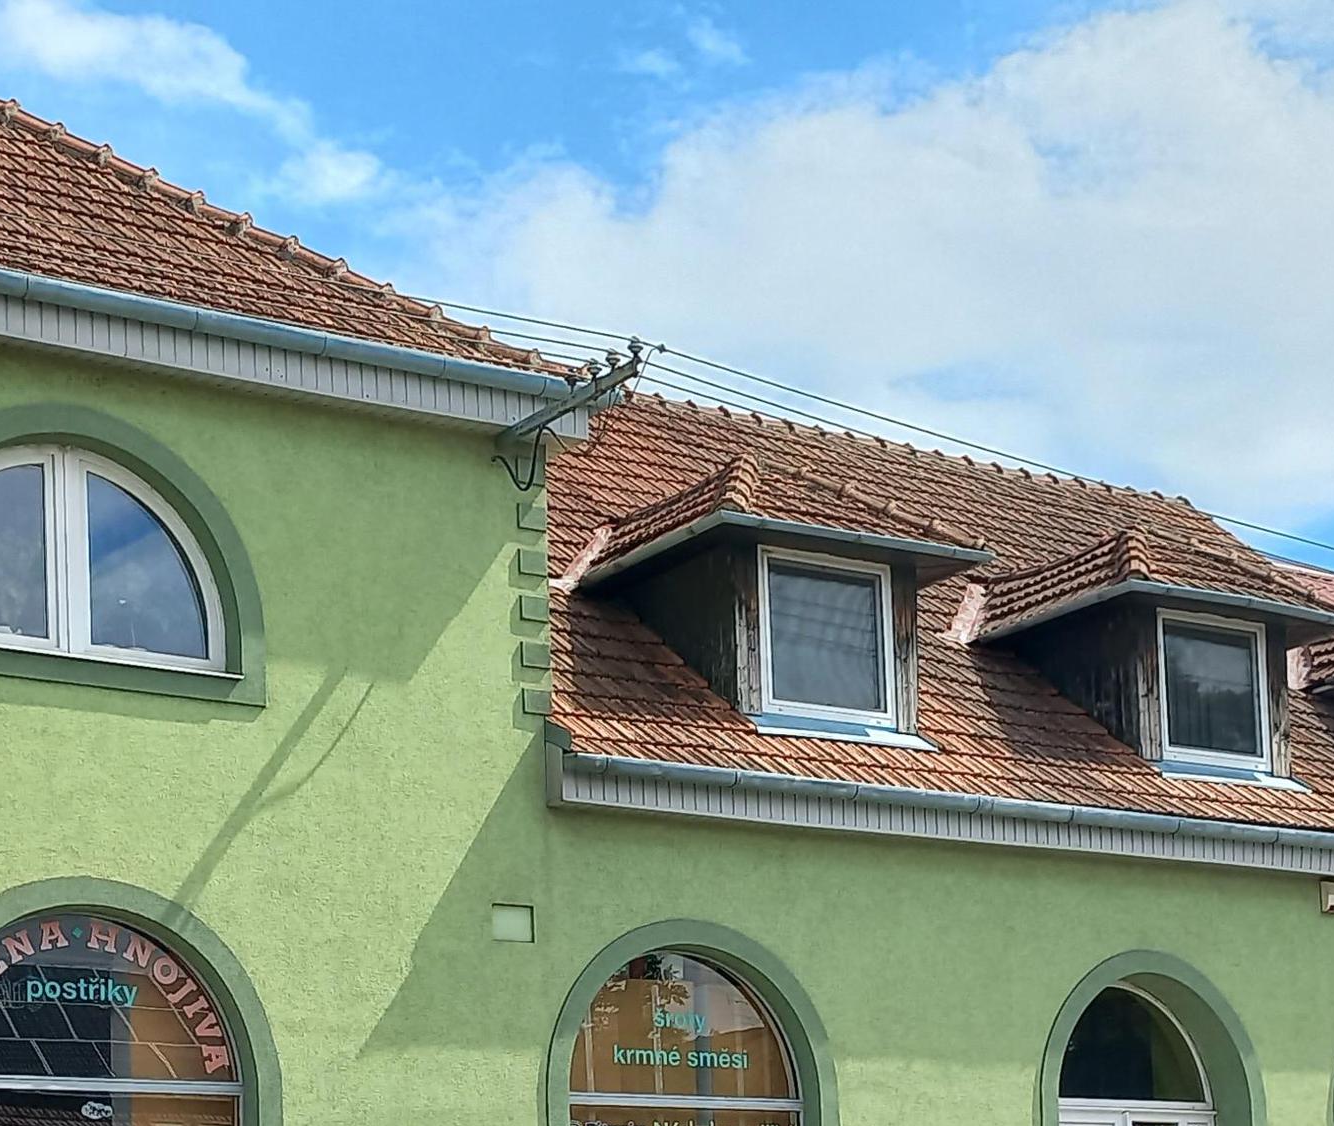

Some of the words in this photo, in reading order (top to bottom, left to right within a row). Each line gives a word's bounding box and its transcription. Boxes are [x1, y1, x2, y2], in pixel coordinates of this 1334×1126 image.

[27, 977, 138, 1007] postřiky
[87, 922, 231, 1074] HNOJIVA
[613, 1045, 681, 1066] krmné
[687, 1049, 748, 1069] směsi
